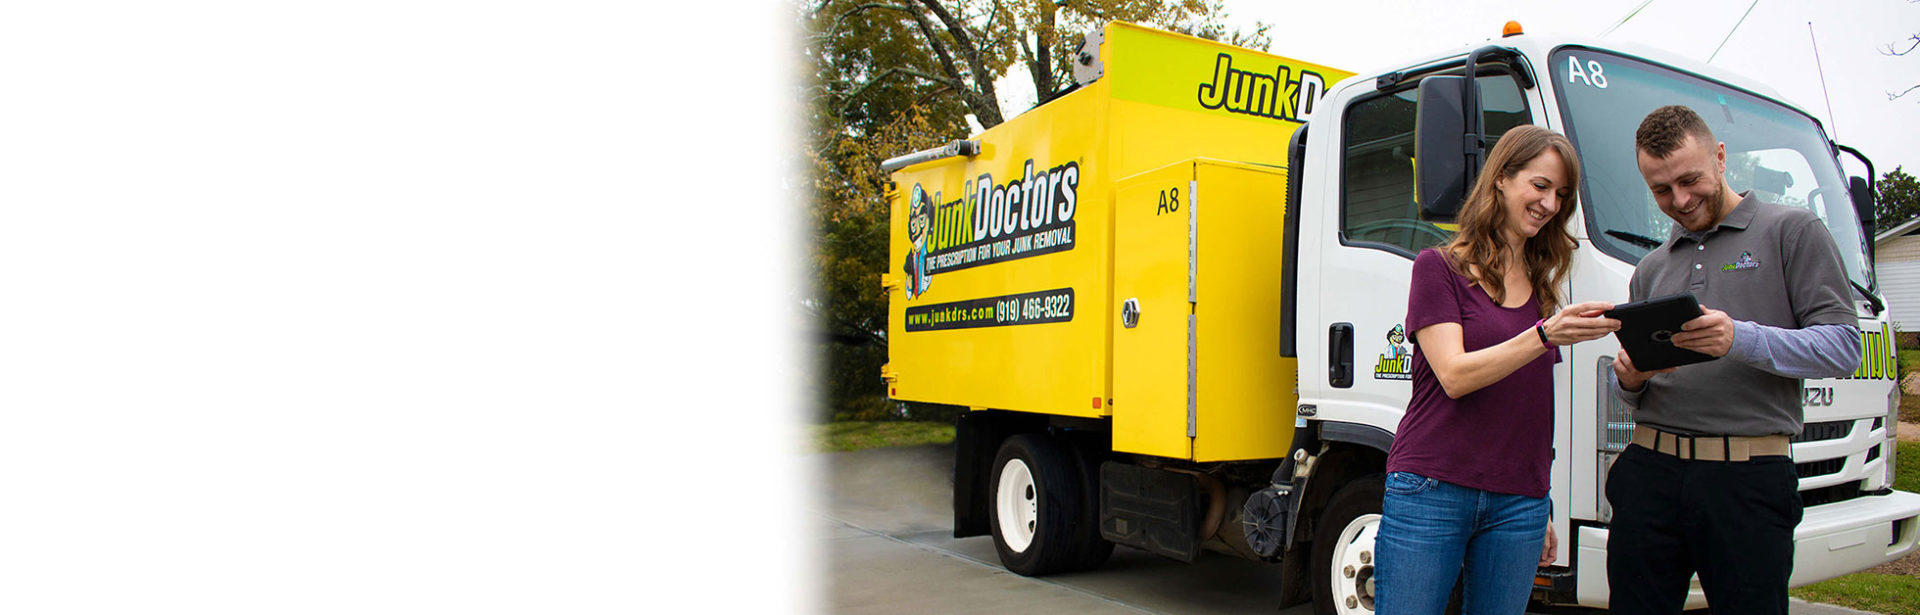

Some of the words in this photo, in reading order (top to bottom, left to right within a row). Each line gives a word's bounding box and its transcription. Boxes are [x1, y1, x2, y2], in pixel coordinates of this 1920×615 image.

[1199, 54, 1324, 122] JunkD
[1568, 55, 1608, 89] A8
[926, 162, 1078, 254] JunkDoctors
[1157, 187, 1179, 216] A8
[925, 256, 936, 271] THE
[936, 247, 977, 269] PRESCRIPTION
[978, 243, 991, 261] FOR
[992, 240, 1011, 258] YOUR
[1012, 234, 1033, 255] JUNK
[1033, 226, 1072, 250] REMOVAL
[908, 306, 994, 327] www.junkdrs.com
[996, 298, 1020, 323] (919)
[1022, 294, 1070, 320] 466-9322
[1375, 354, 1412, 373] JunkD
